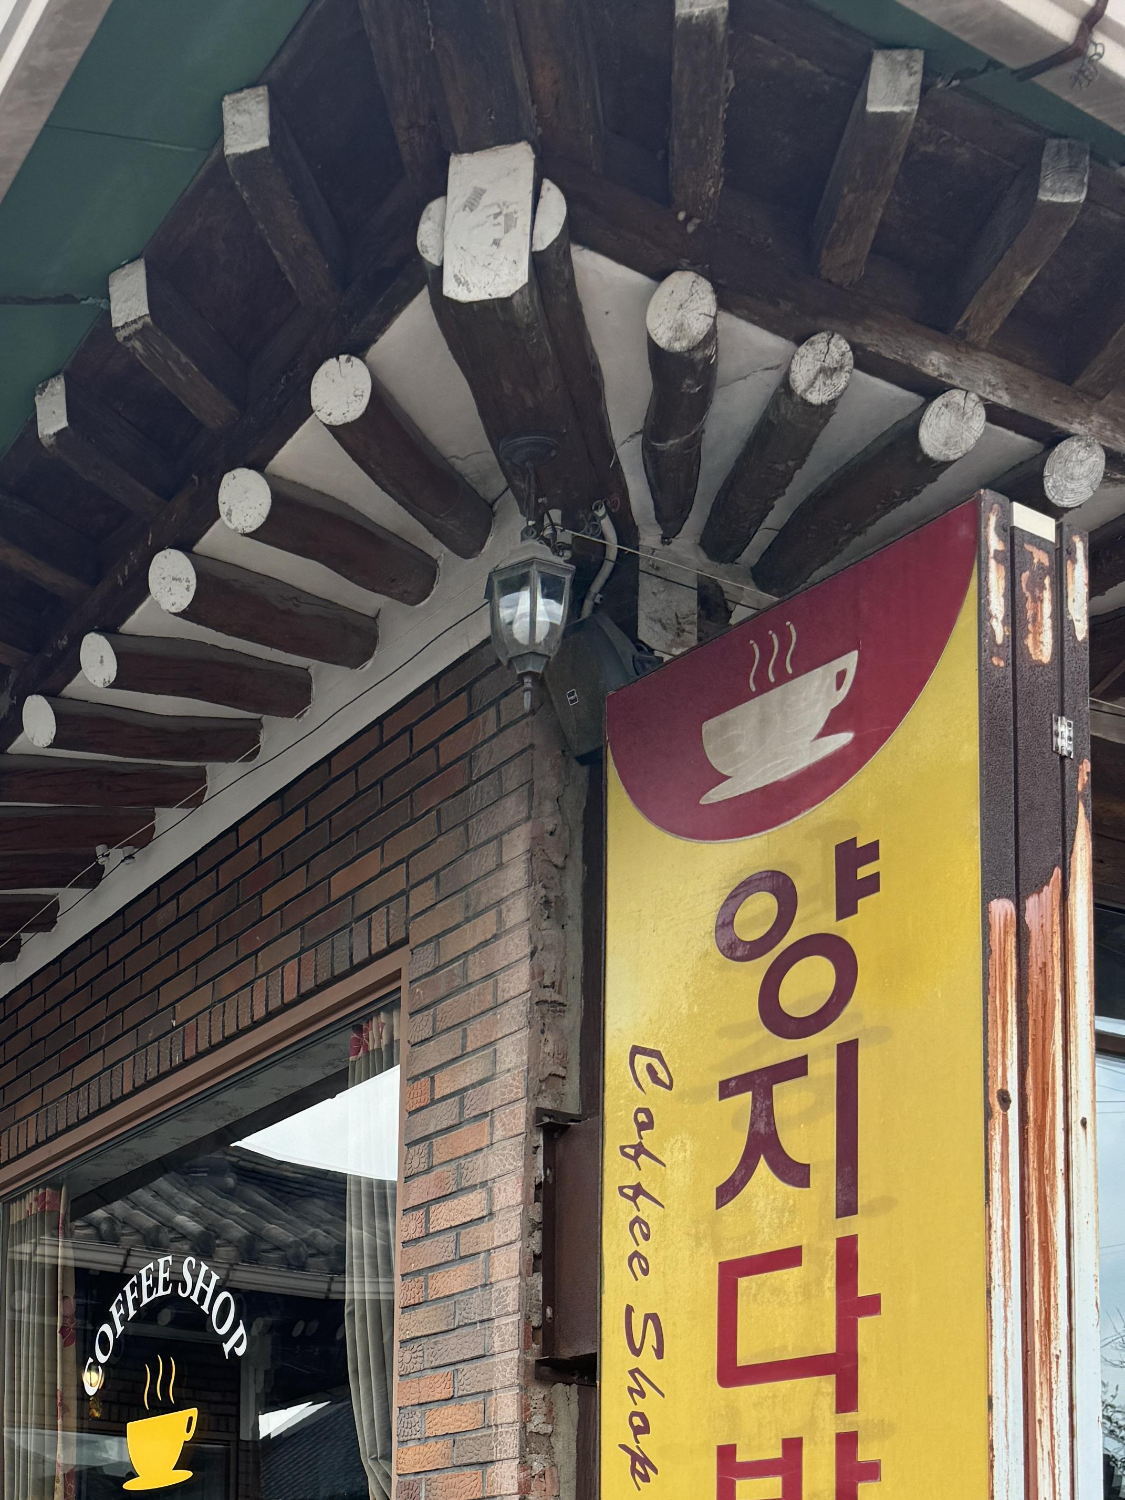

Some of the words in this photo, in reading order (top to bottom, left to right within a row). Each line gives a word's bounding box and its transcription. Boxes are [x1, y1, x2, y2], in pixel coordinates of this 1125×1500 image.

[618, 1044, 675, 1282] Coffee
[83, 1255, 173, 1396] COFFEE
[177, 1256, 248, 1359] SHOP
[618, 1303, 666, 1492] Shop
